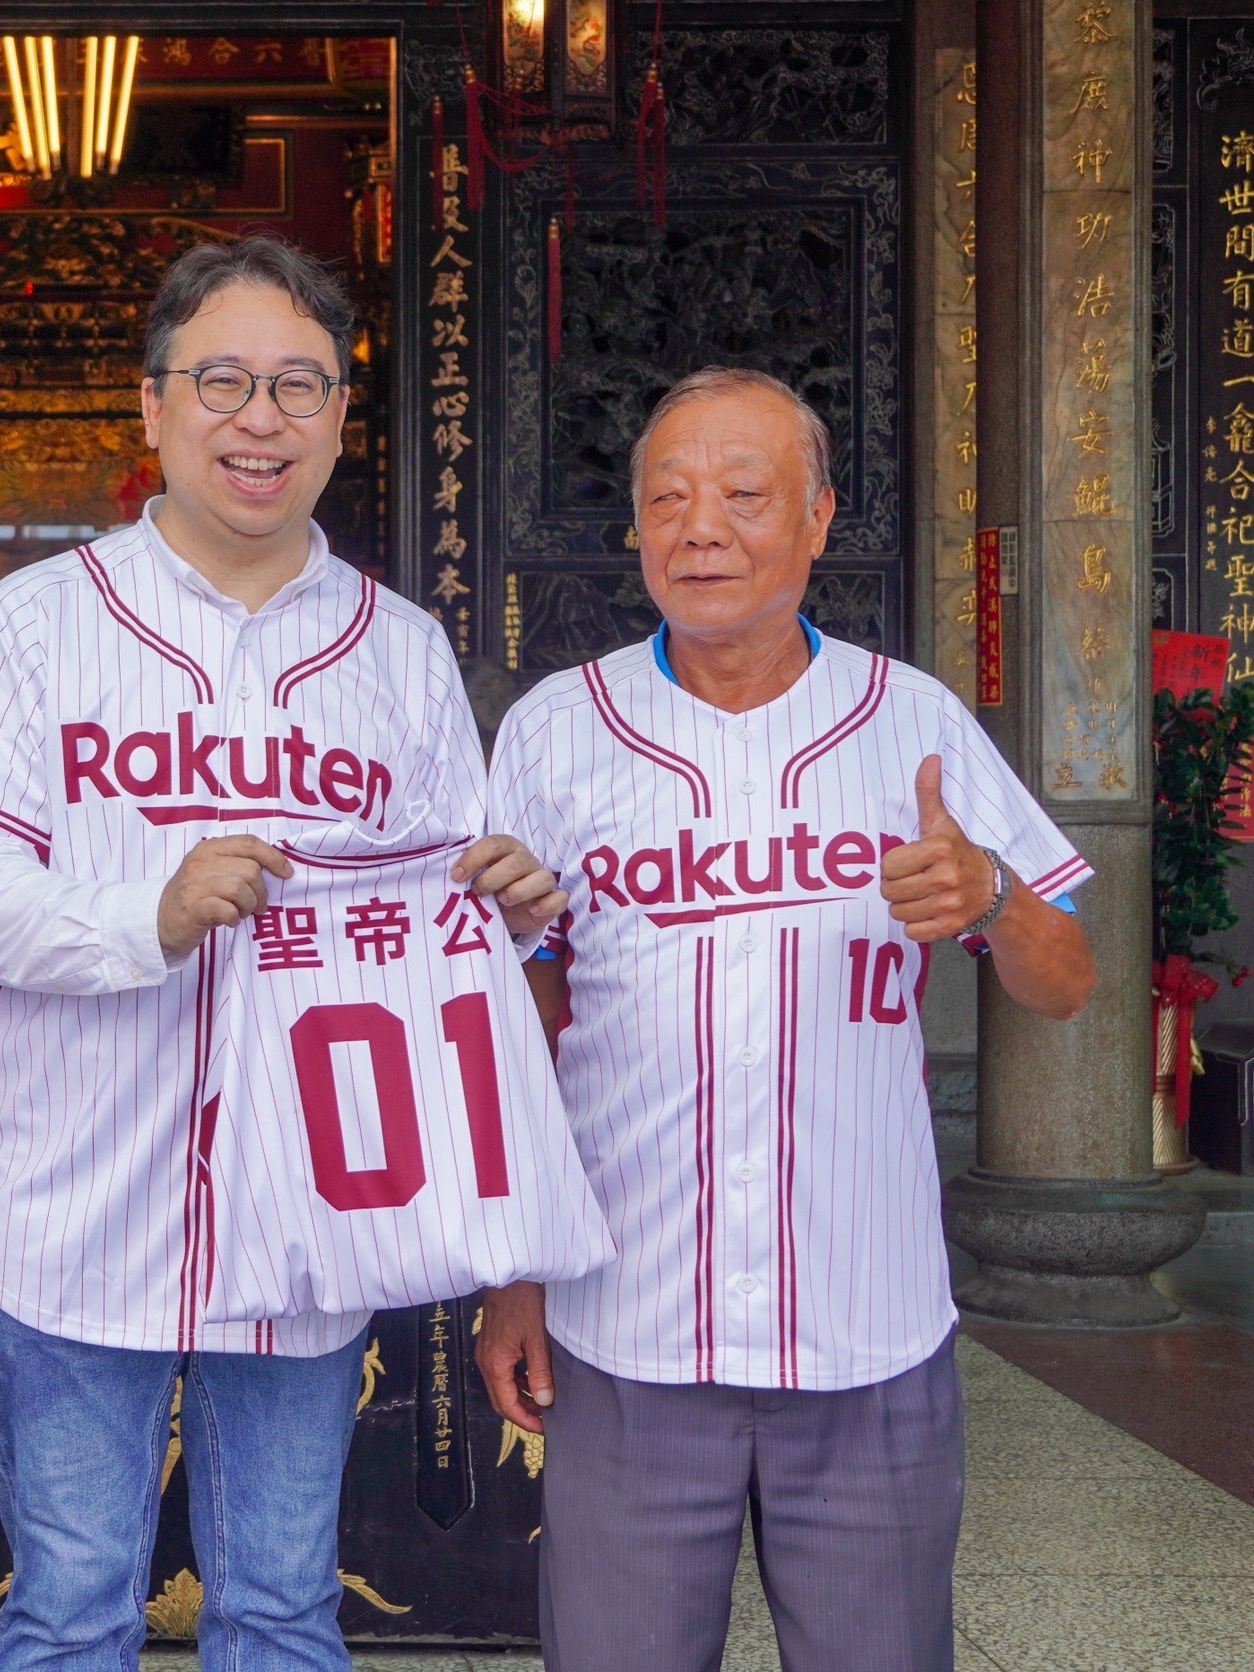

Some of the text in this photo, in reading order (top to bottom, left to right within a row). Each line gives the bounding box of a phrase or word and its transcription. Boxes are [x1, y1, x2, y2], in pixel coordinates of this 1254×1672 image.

[61, 711, 393, 831] Rakuten
[252, 889, 493, 972] 聖帝公
[848, 937, 906, 1025] 10
[289, 991, 510, 1212] 01
